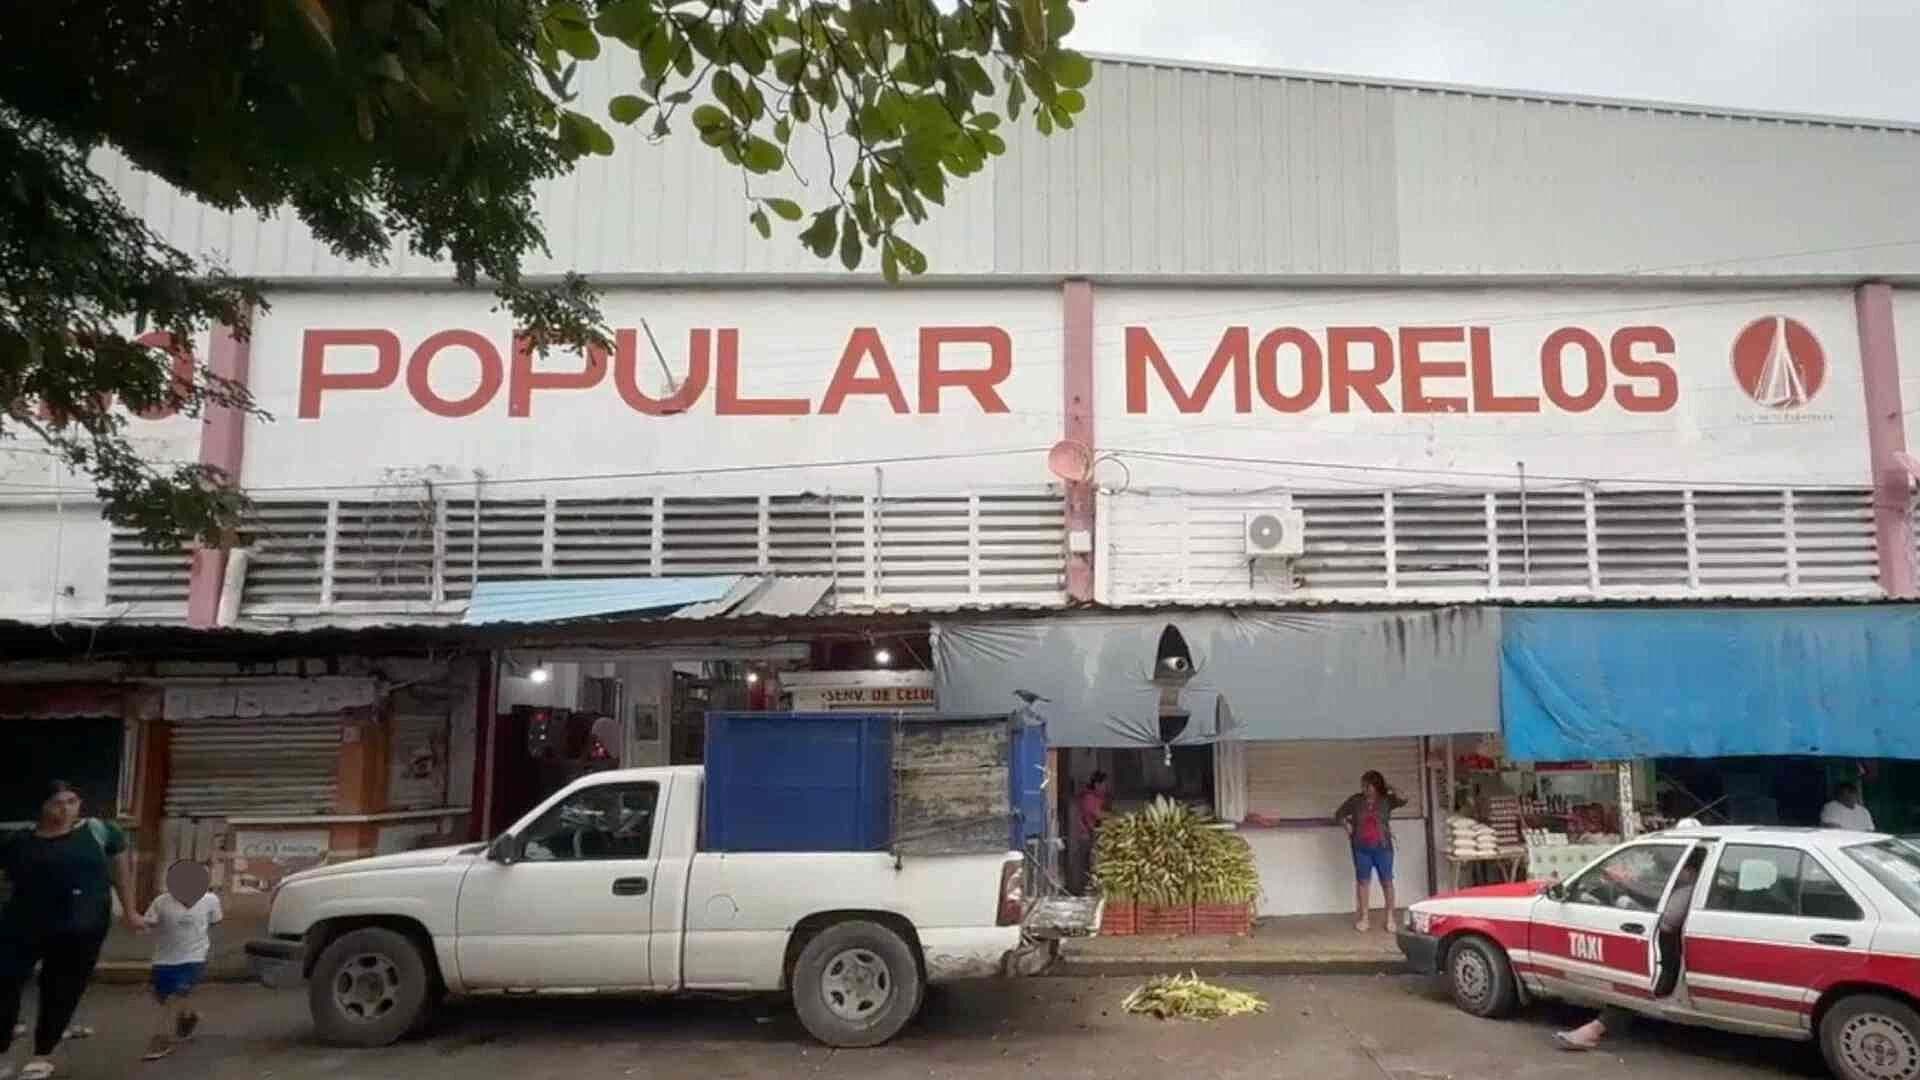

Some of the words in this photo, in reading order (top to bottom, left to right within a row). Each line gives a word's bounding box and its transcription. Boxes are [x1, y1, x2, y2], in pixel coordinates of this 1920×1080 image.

[299, 326, 1013, 418] POPULAR
[1124, 326, 1679, 414] MORELOS
[872, 688, 891, 701] DE
[1568, 931, 1604, 962] TAXI
